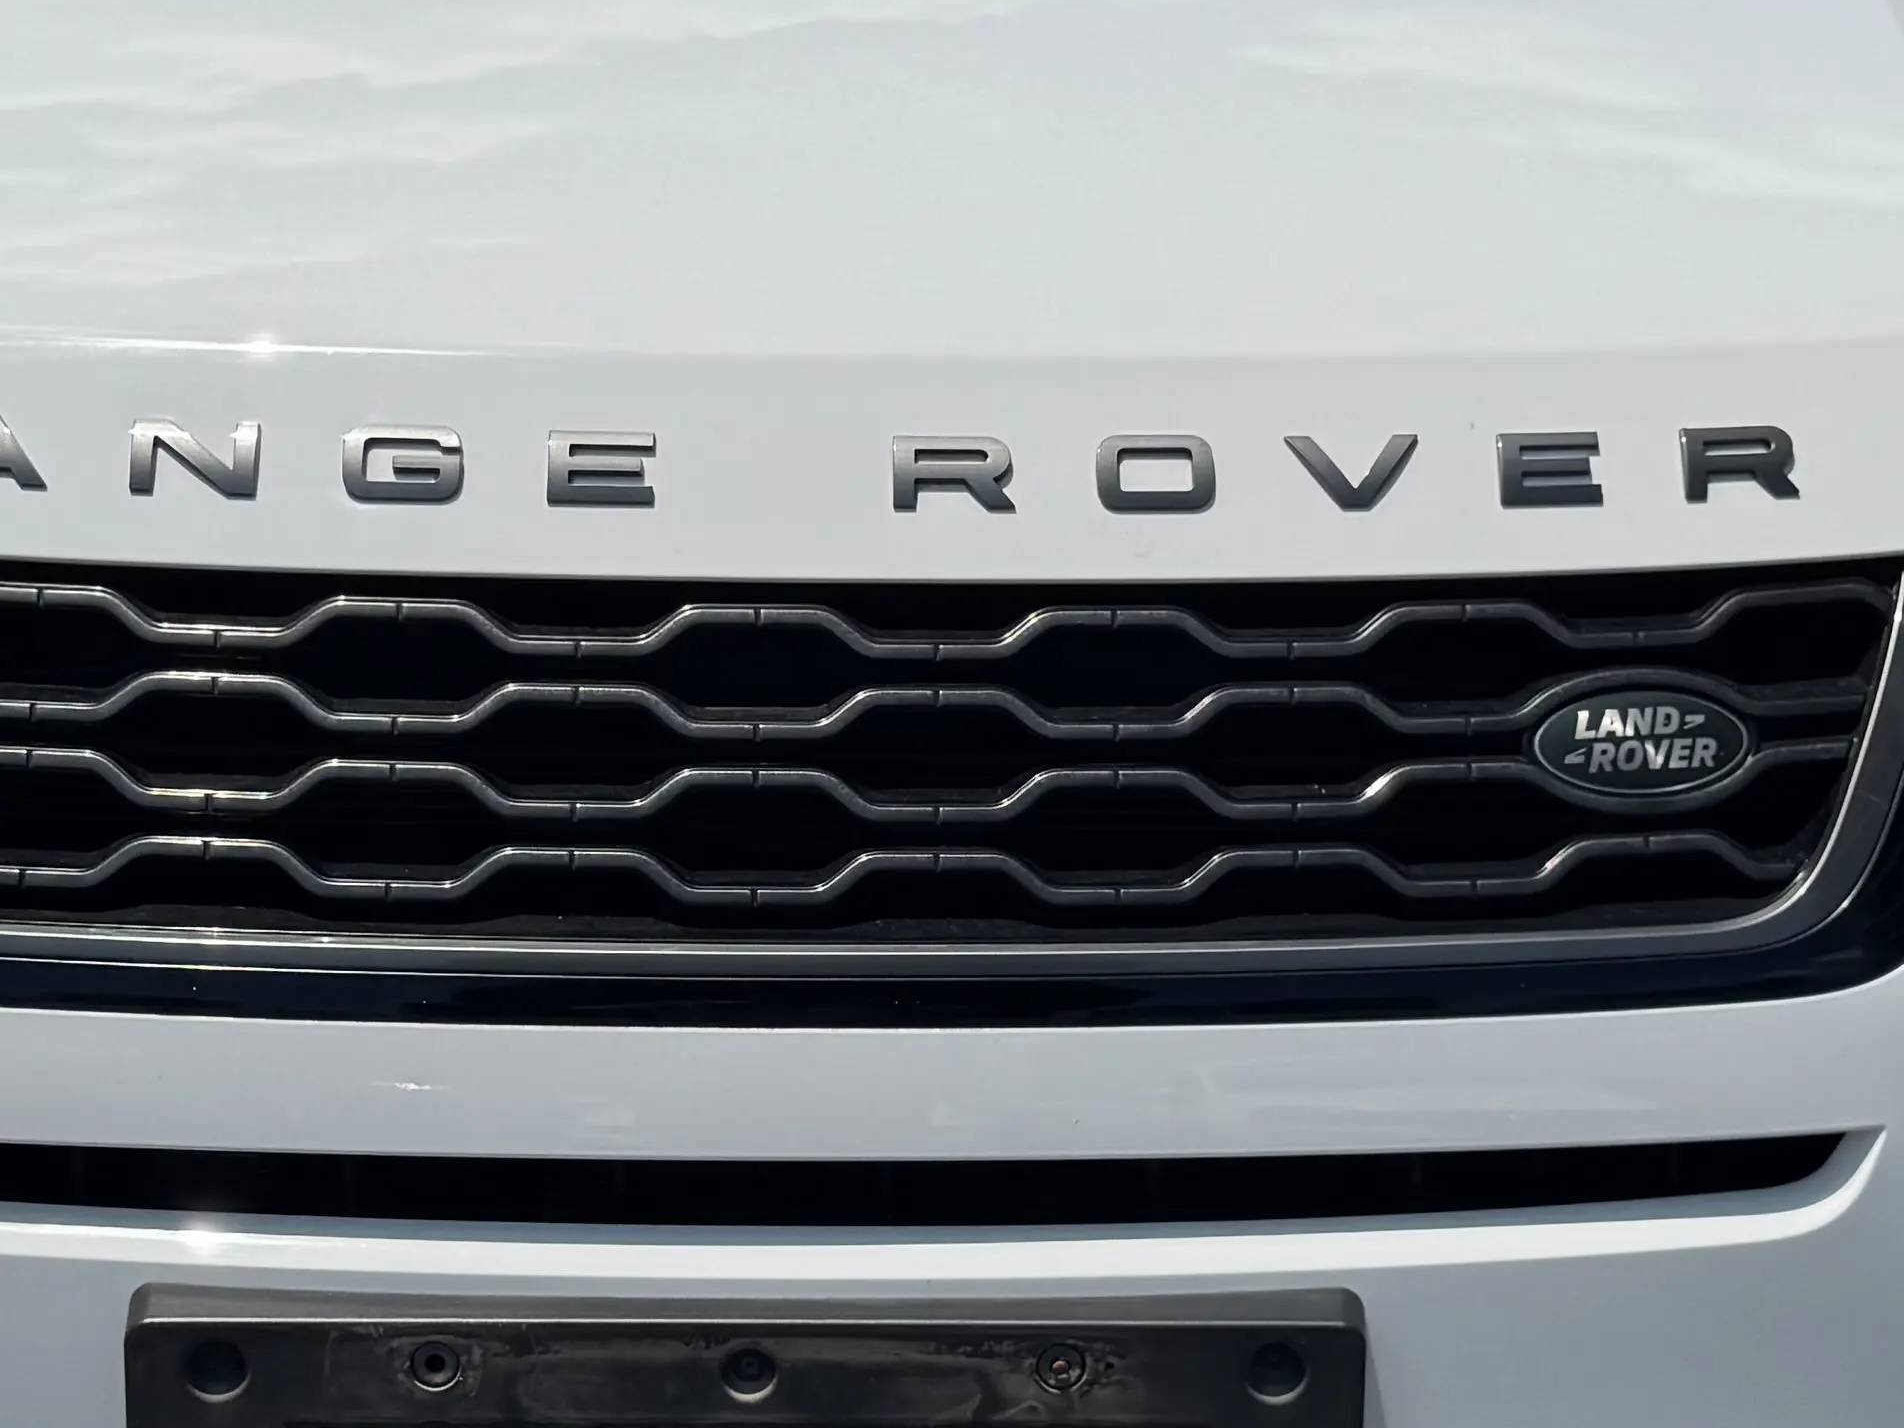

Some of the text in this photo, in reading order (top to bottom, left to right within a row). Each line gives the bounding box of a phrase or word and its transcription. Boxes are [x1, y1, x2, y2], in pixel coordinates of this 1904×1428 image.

[891, 424, 1801, 513] ROVER
[1575, 706, 1680, 740] LAND
[1589, 737, 1717, 773] ROVER
